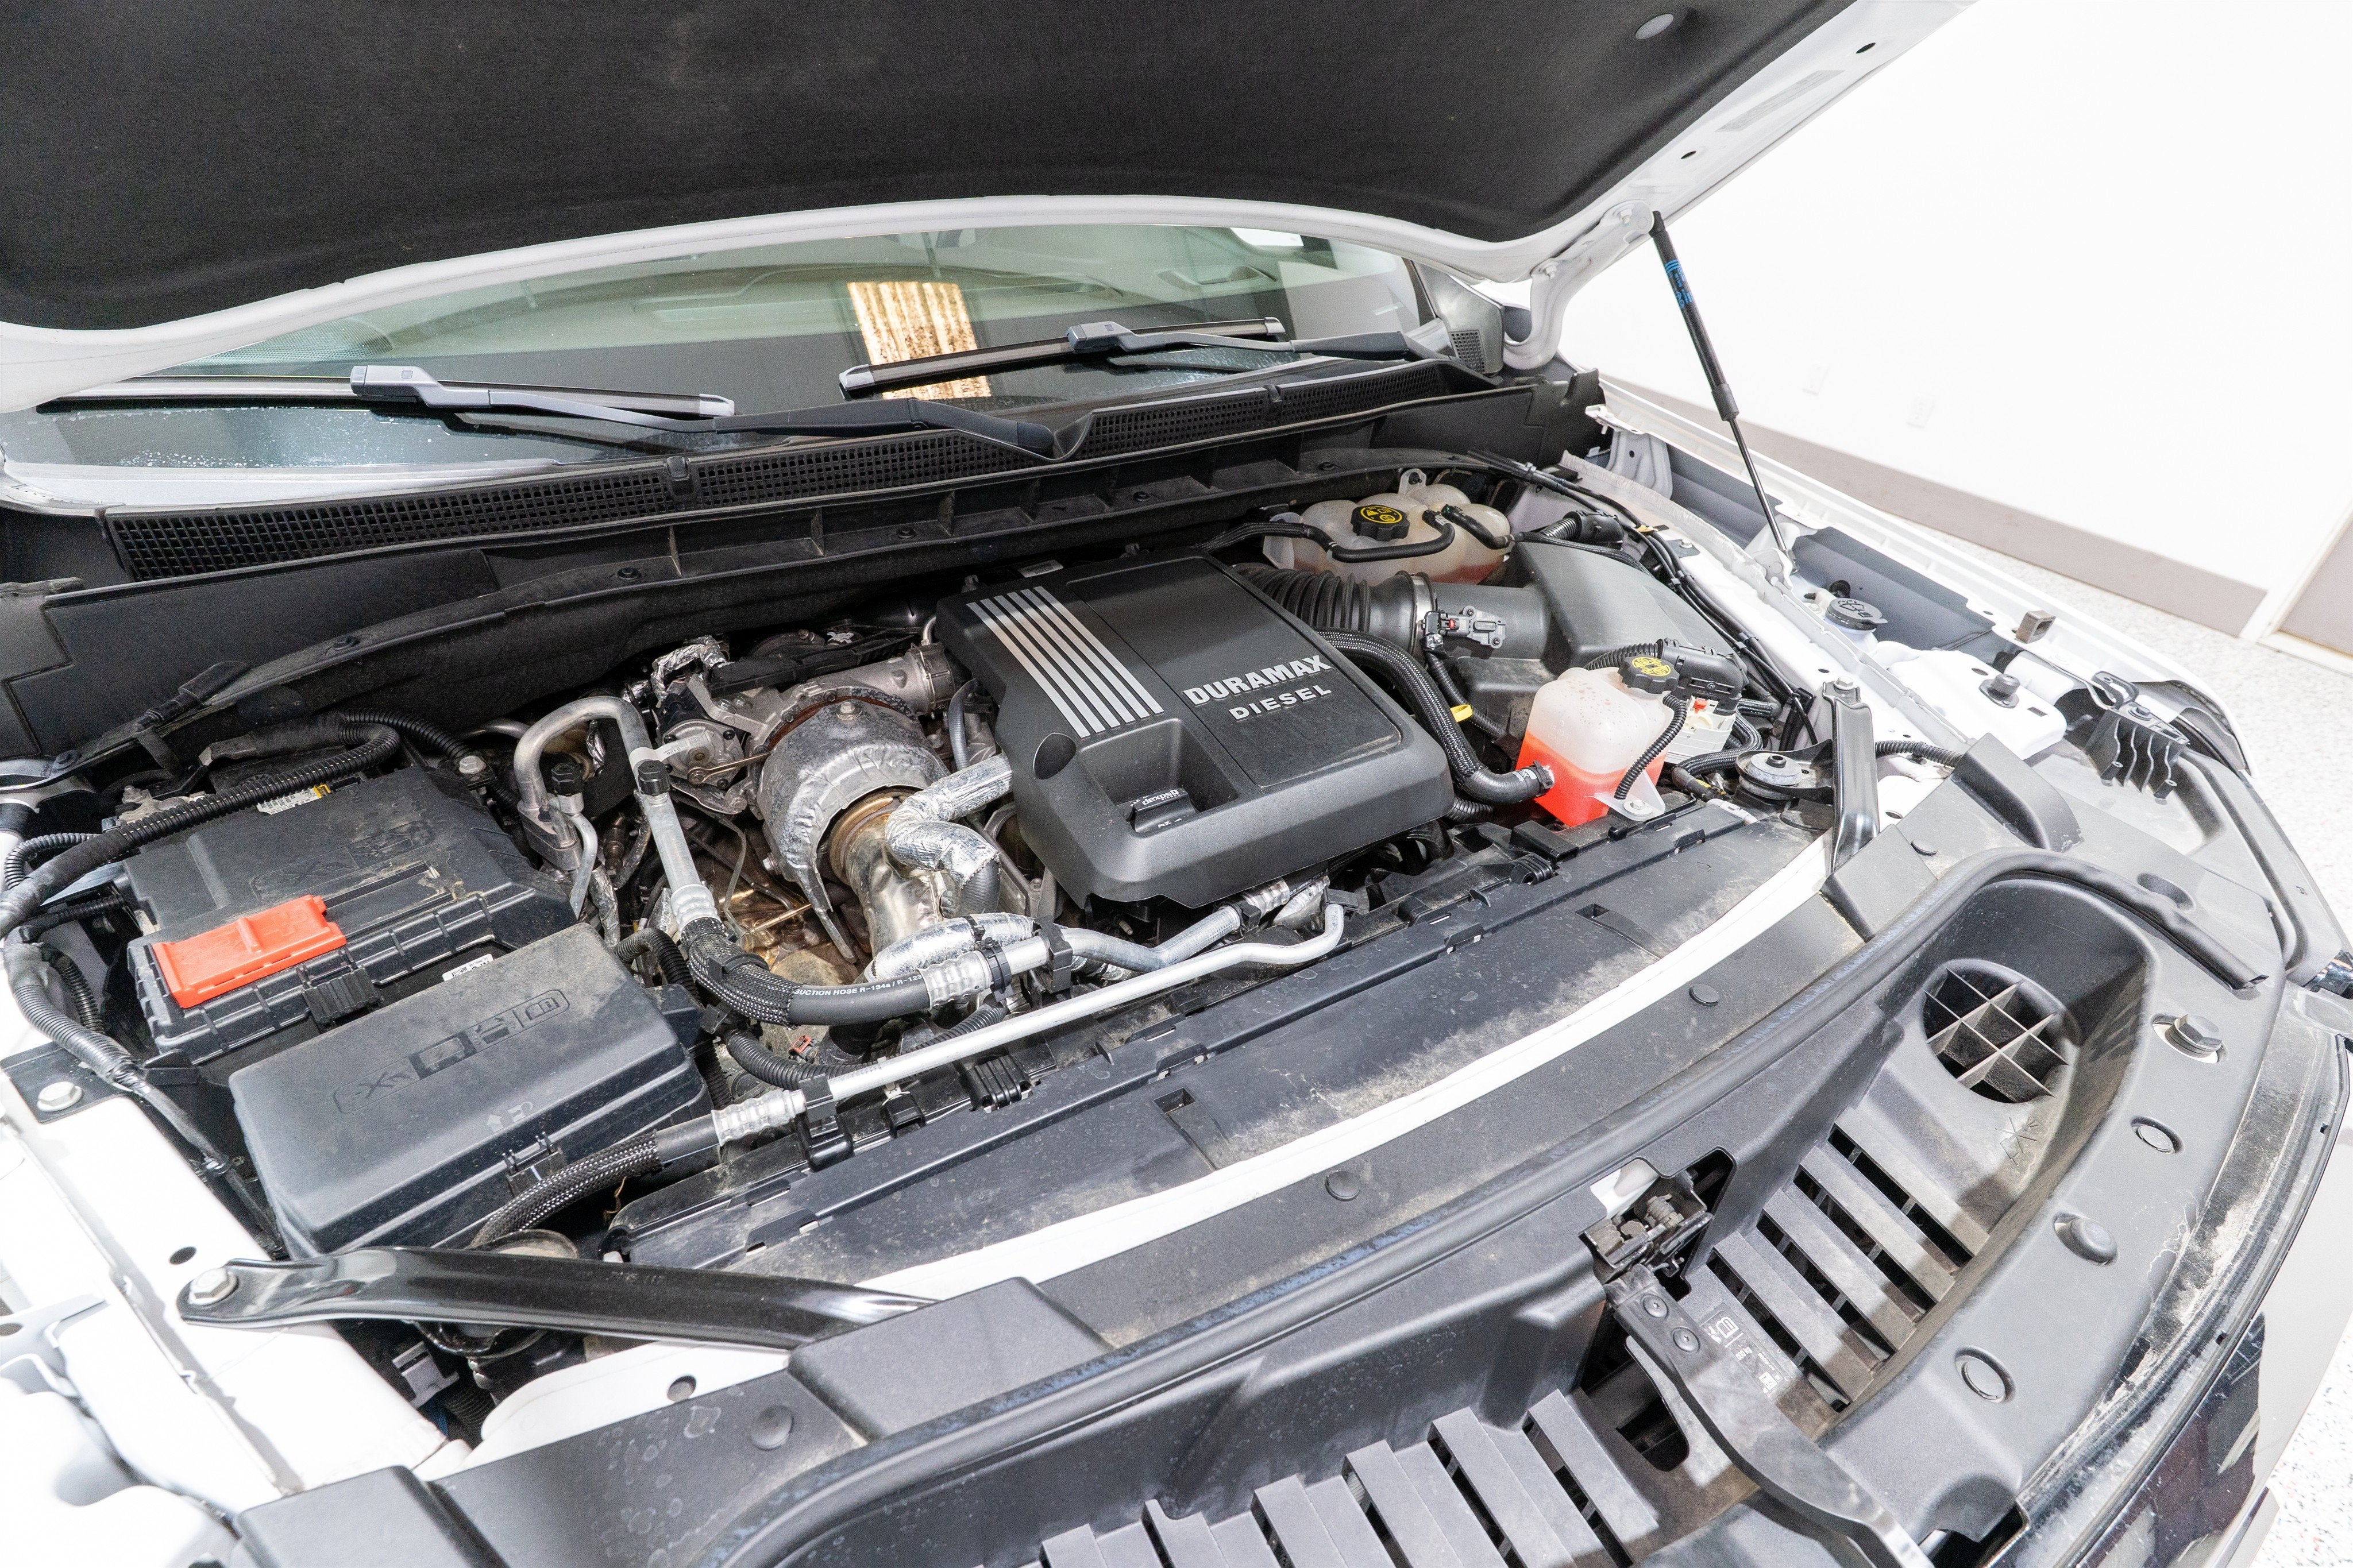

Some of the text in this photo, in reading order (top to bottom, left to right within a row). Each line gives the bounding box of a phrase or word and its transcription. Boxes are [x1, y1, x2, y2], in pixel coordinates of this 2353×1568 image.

[1183, 655, 1332, 706] DURAMAX
[1228, 685, 1332, 721] DIESEL
[859, 983, 891, 992] R-134a
